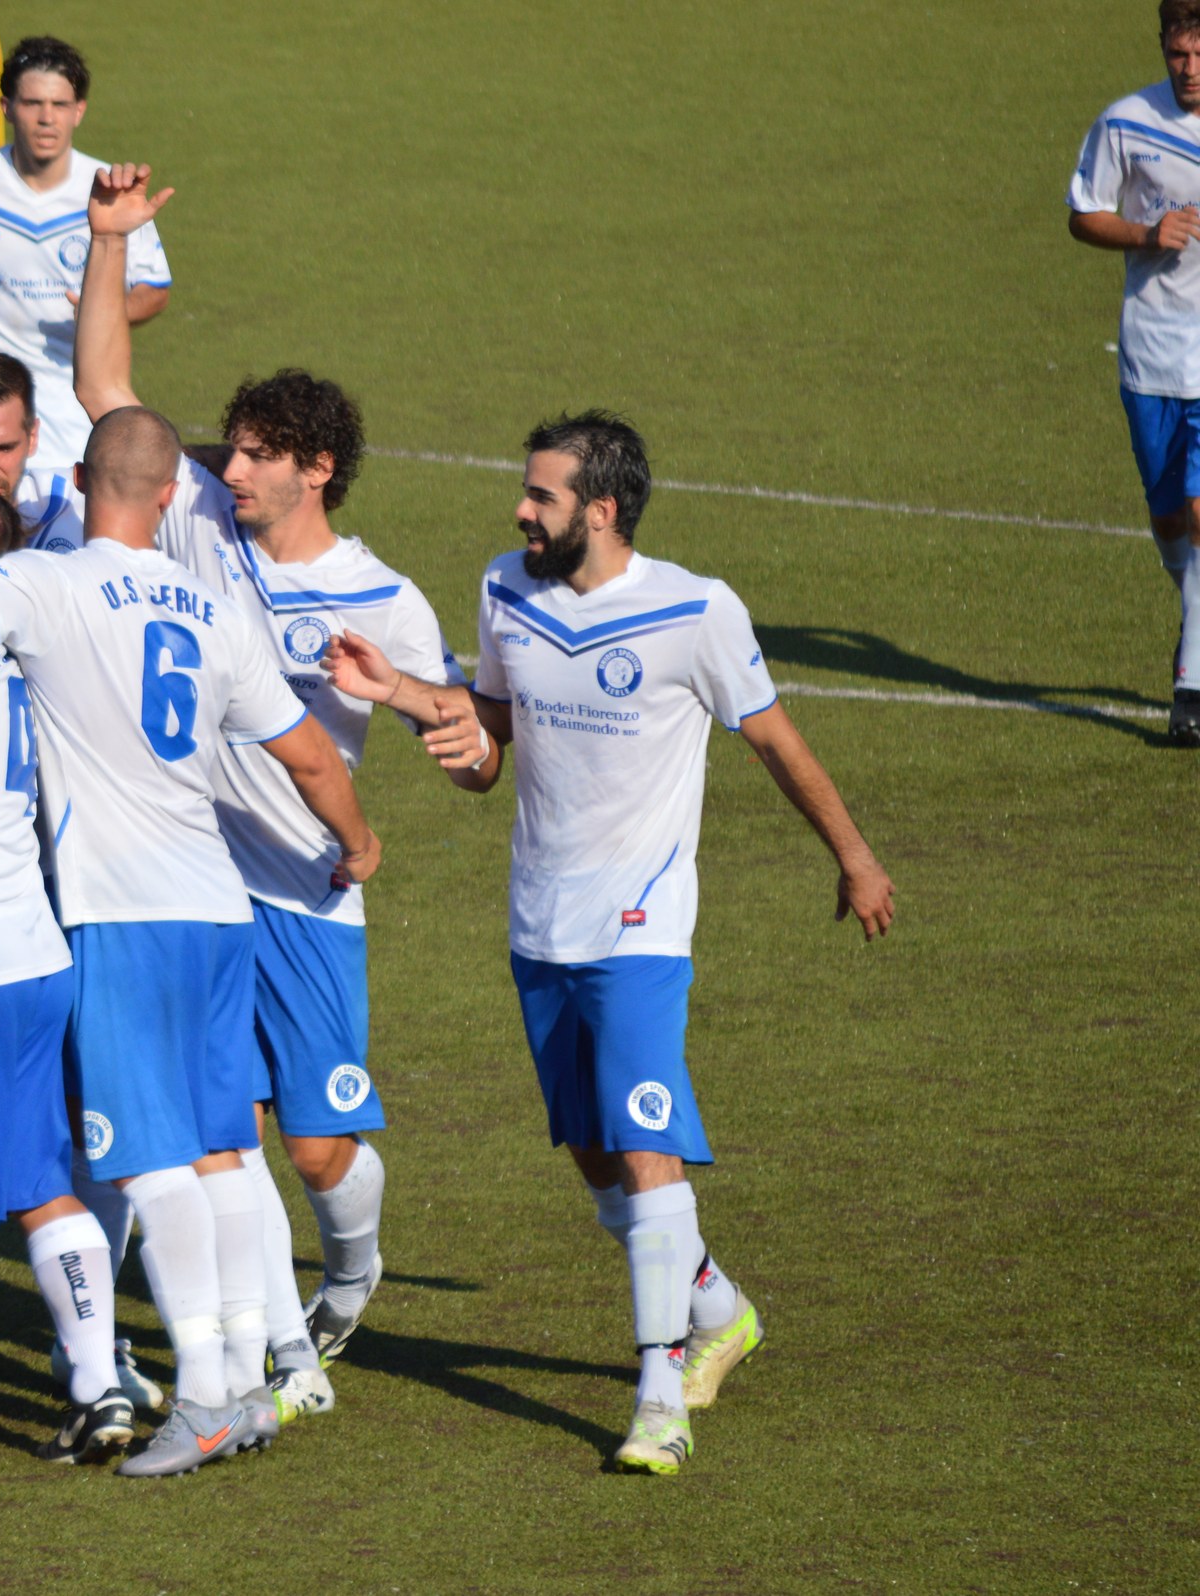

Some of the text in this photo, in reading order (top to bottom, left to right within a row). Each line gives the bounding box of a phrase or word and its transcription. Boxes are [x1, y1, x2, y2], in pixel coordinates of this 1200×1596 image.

[141, 620, 202, 763] 6
[535, 699, 640, 721] Bodei Fiorenzo
[536, 715, 545, 726] &
[550, 715, 619, 736] Raimondo
[59, 1251, 95, 1321] SERLE
